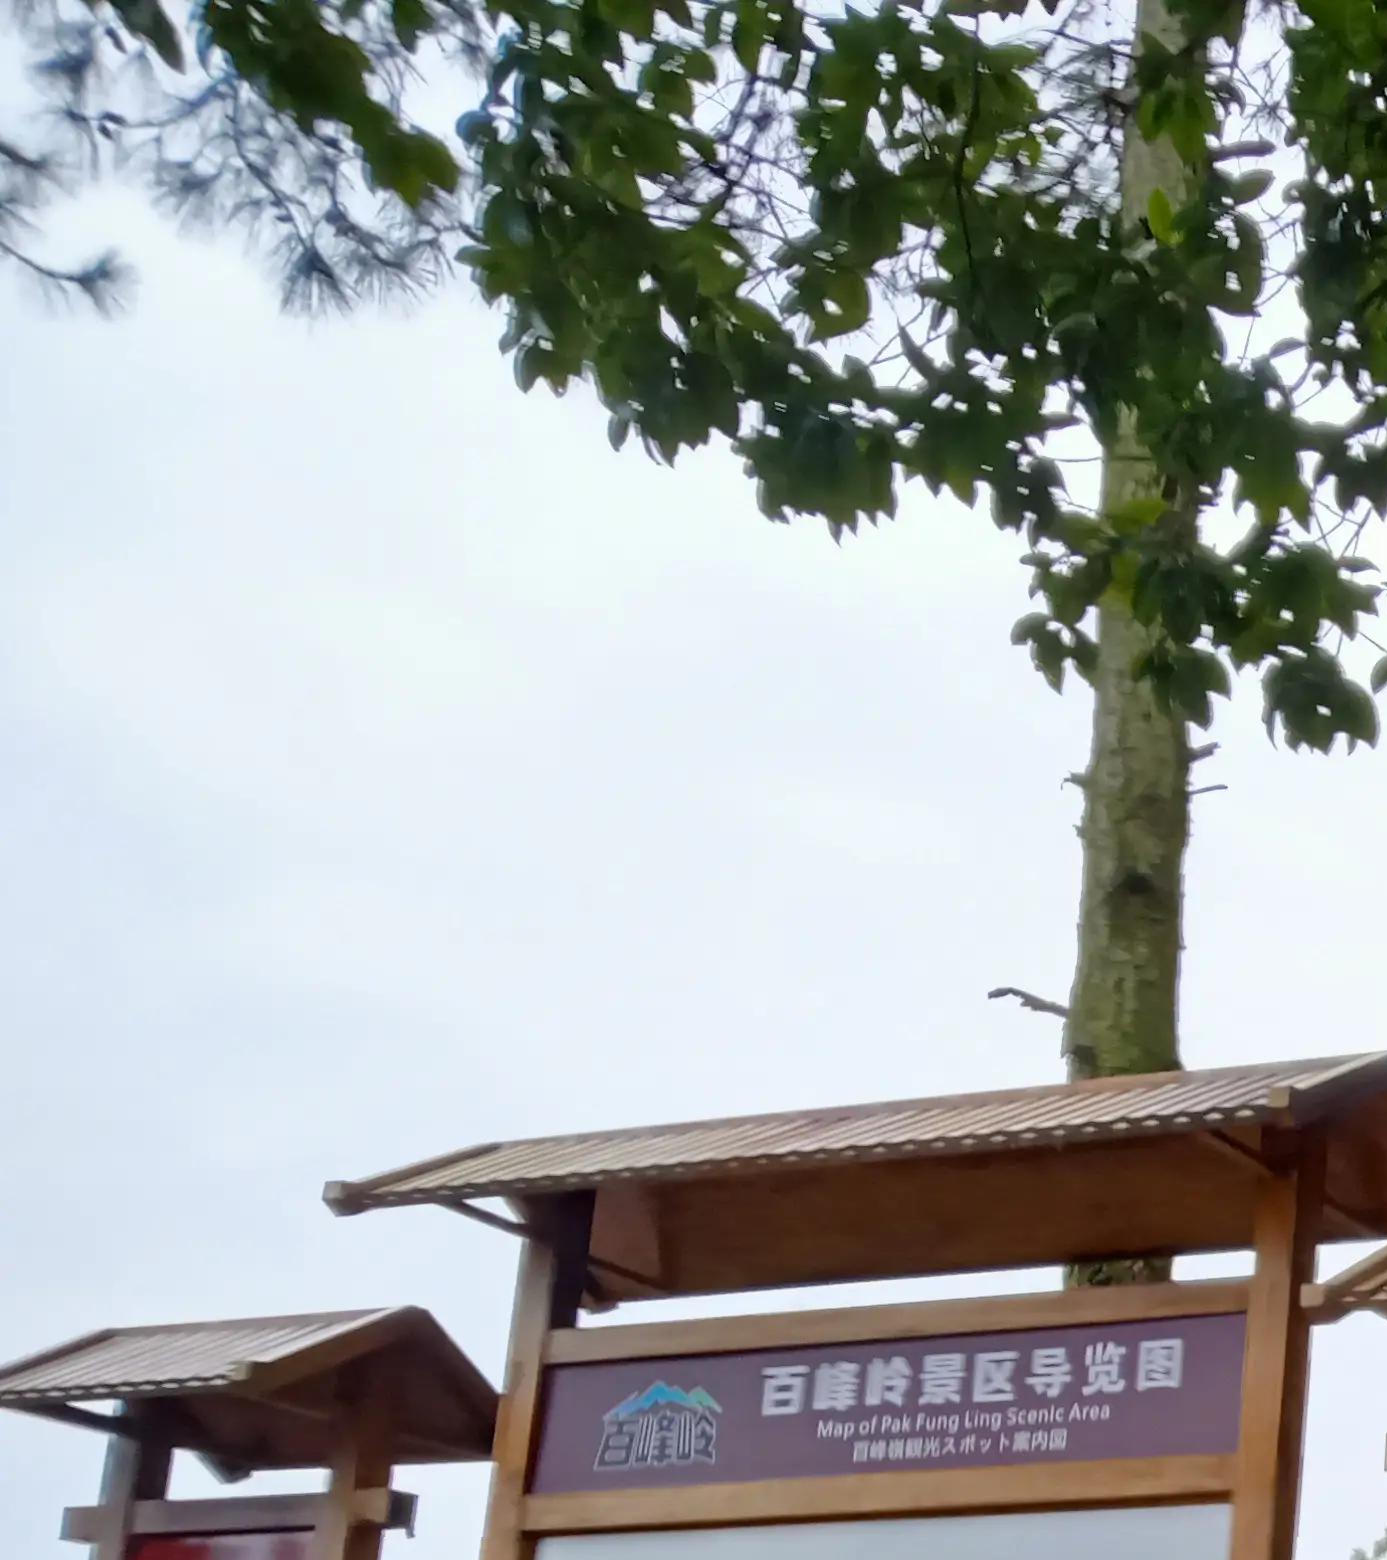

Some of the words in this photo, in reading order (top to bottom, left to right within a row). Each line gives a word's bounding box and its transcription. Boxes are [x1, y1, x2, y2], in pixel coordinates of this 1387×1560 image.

[761, 1338, 1184, 1416] 百峰岭景区导览图
[593, 1408, 718, 1472] 百峰岭
[816, 1418, 855, 1441] Map
[858, 1414, 877, 1436] of
[880, 1411, 911, 1434] Pak
[915, 1411, 960, 1434] Fung
[963, 1407, 1002, 1431] Ling
[1006, 1403, 1065, 1426] Scenic
[1068, 1401, 1111, 1422] Area
